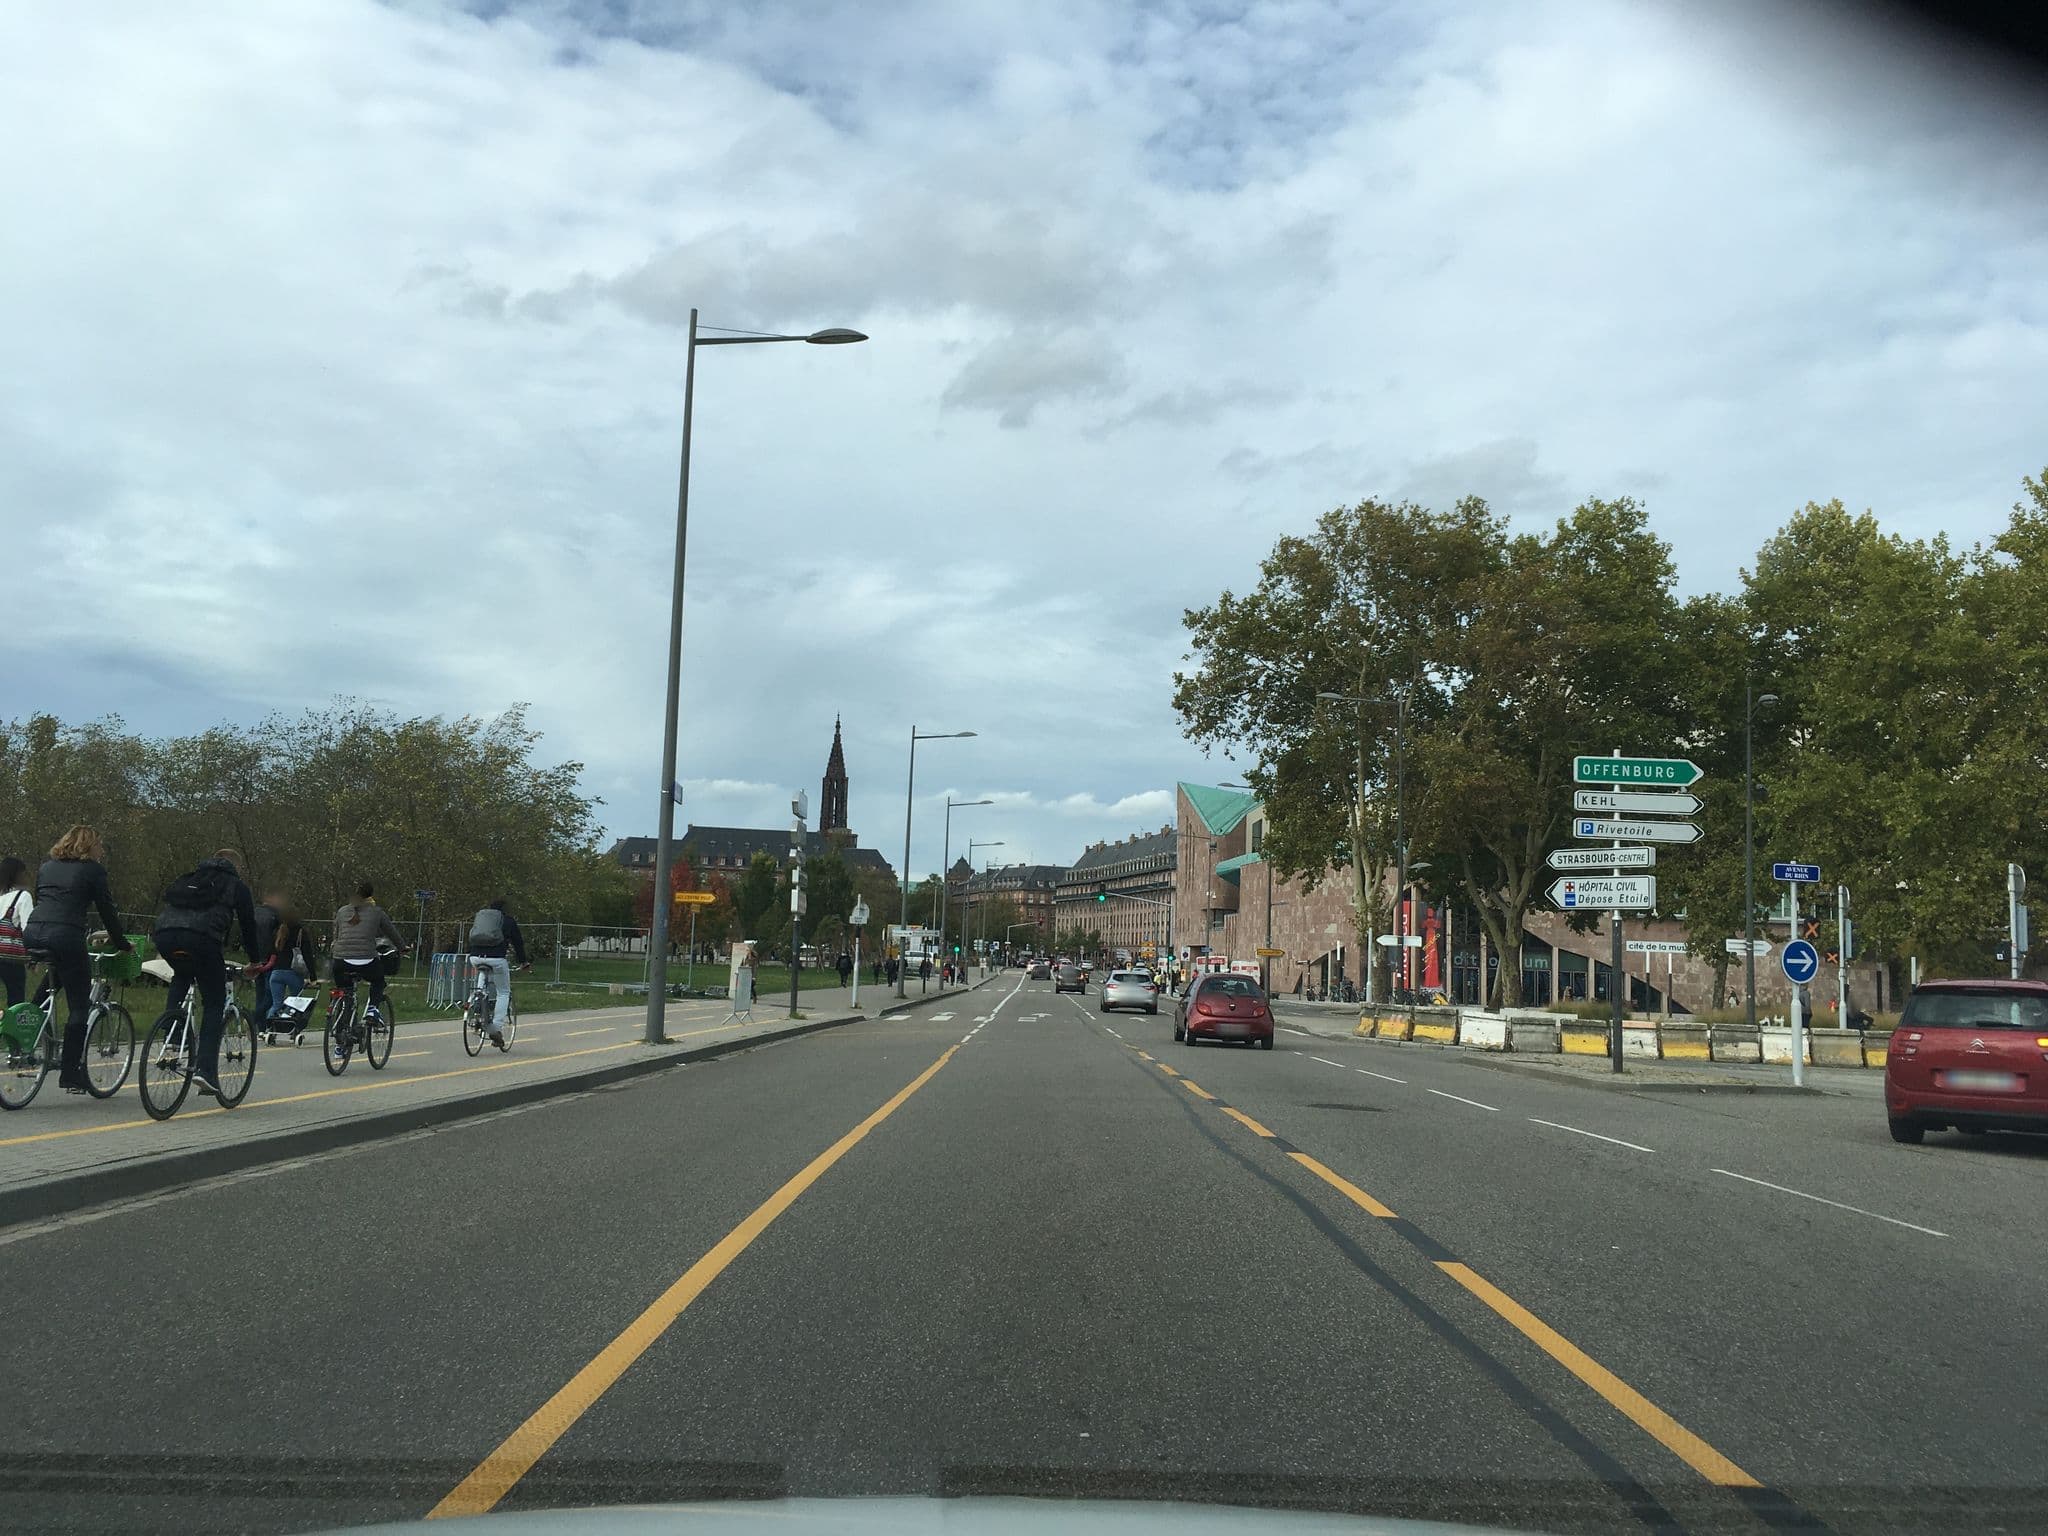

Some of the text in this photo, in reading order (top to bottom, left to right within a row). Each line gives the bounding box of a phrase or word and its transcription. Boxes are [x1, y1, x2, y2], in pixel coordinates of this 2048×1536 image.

[1582, 764, 1675, 778] OFFENBURG
[1581, 796, 1617, 806] KEHL
[1596, 824, 1653, 836] Rivetoile
[1578, 881, 1637, 892] HÔPITAL CIVIL
[1578, 892, 1649, 905] Dépose Etoile
[1646, 943, 1657, 951] de
[1658, 943, 1667, 951] la
